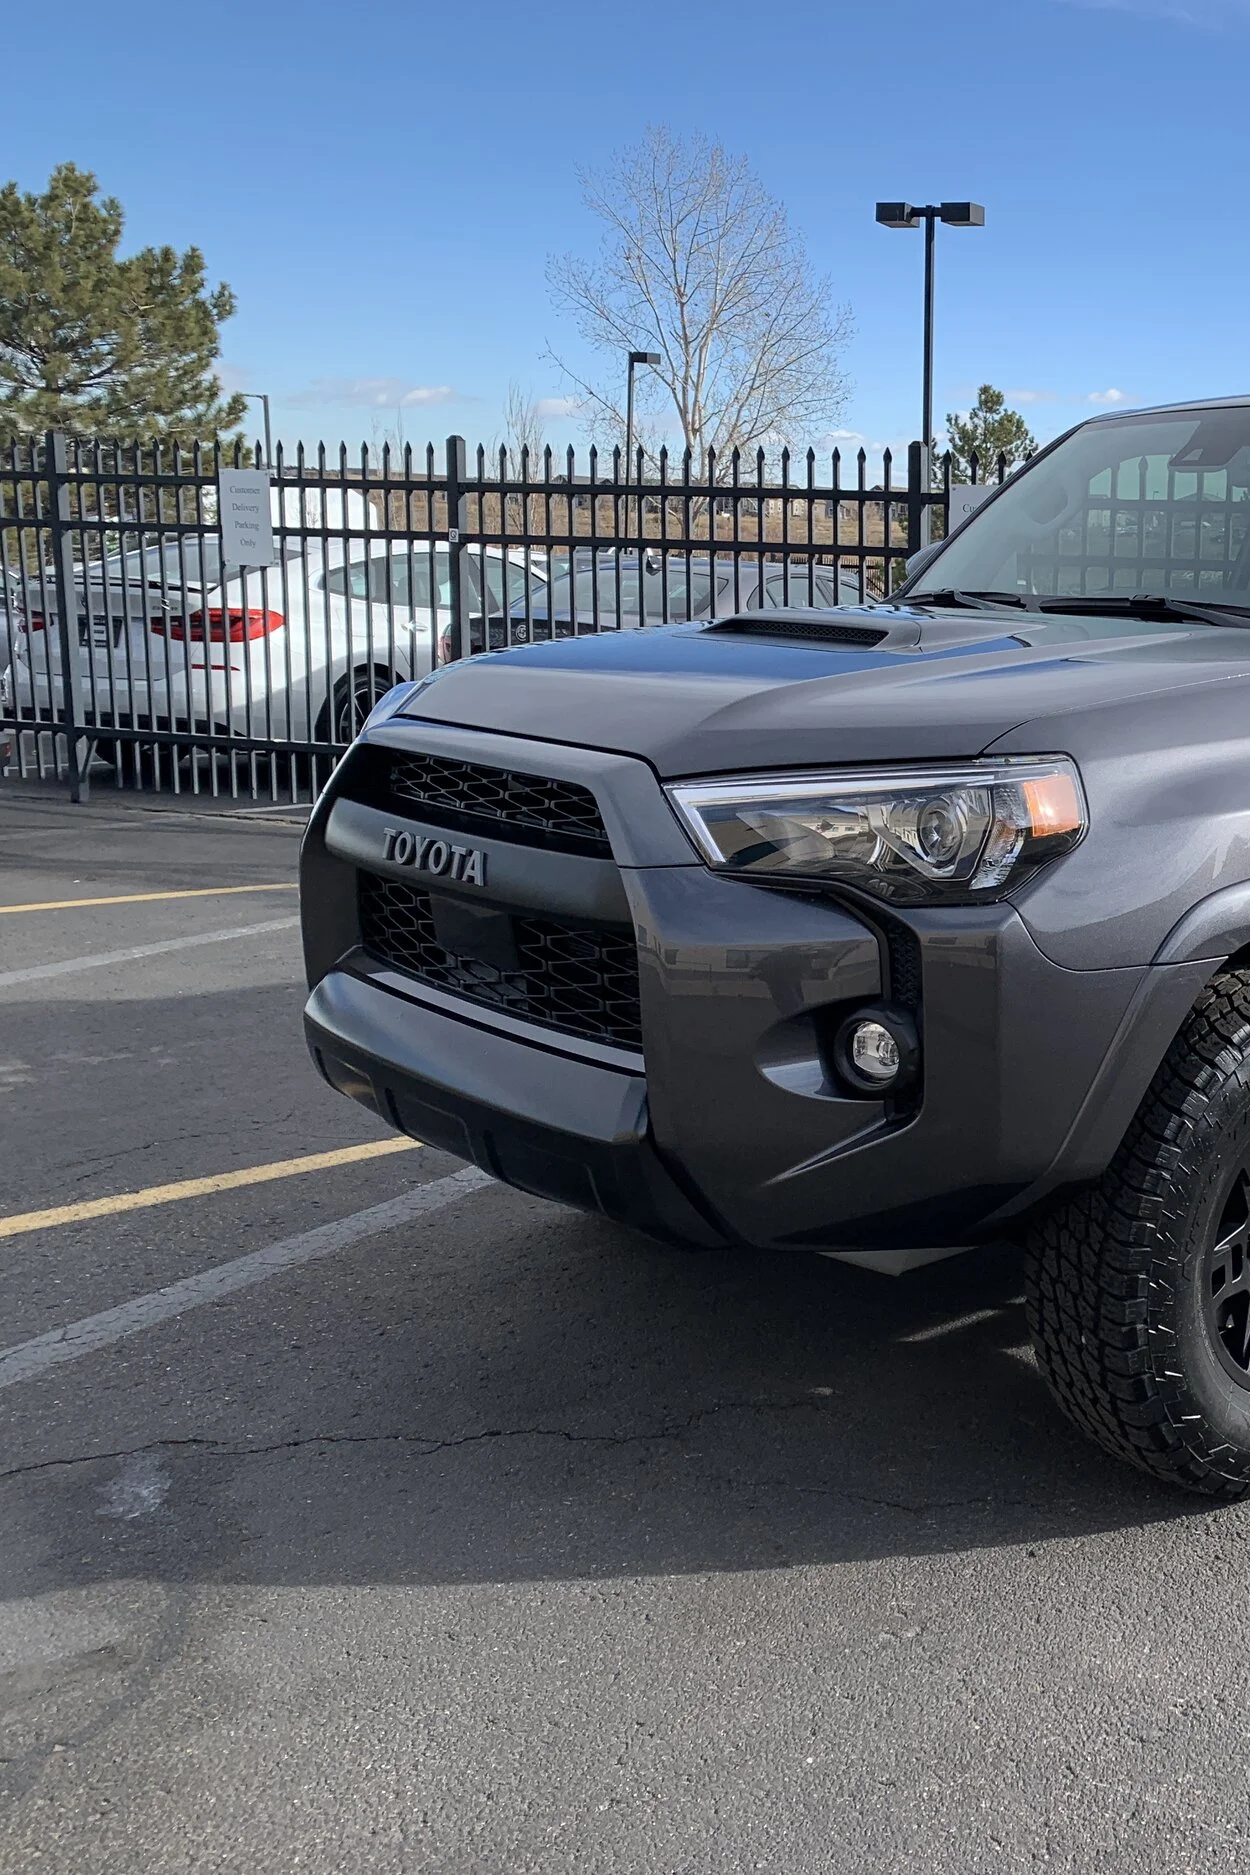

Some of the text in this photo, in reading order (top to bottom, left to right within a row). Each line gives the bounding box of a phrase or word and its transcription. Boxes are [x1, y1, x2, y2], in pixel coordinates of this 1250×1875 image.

[232, 503, 260, 513] Delivery
[234, 521, 260, 531] Parking
[240, 539, 256, 548] Only
[382, 827, 487, 887] TOYOTA
